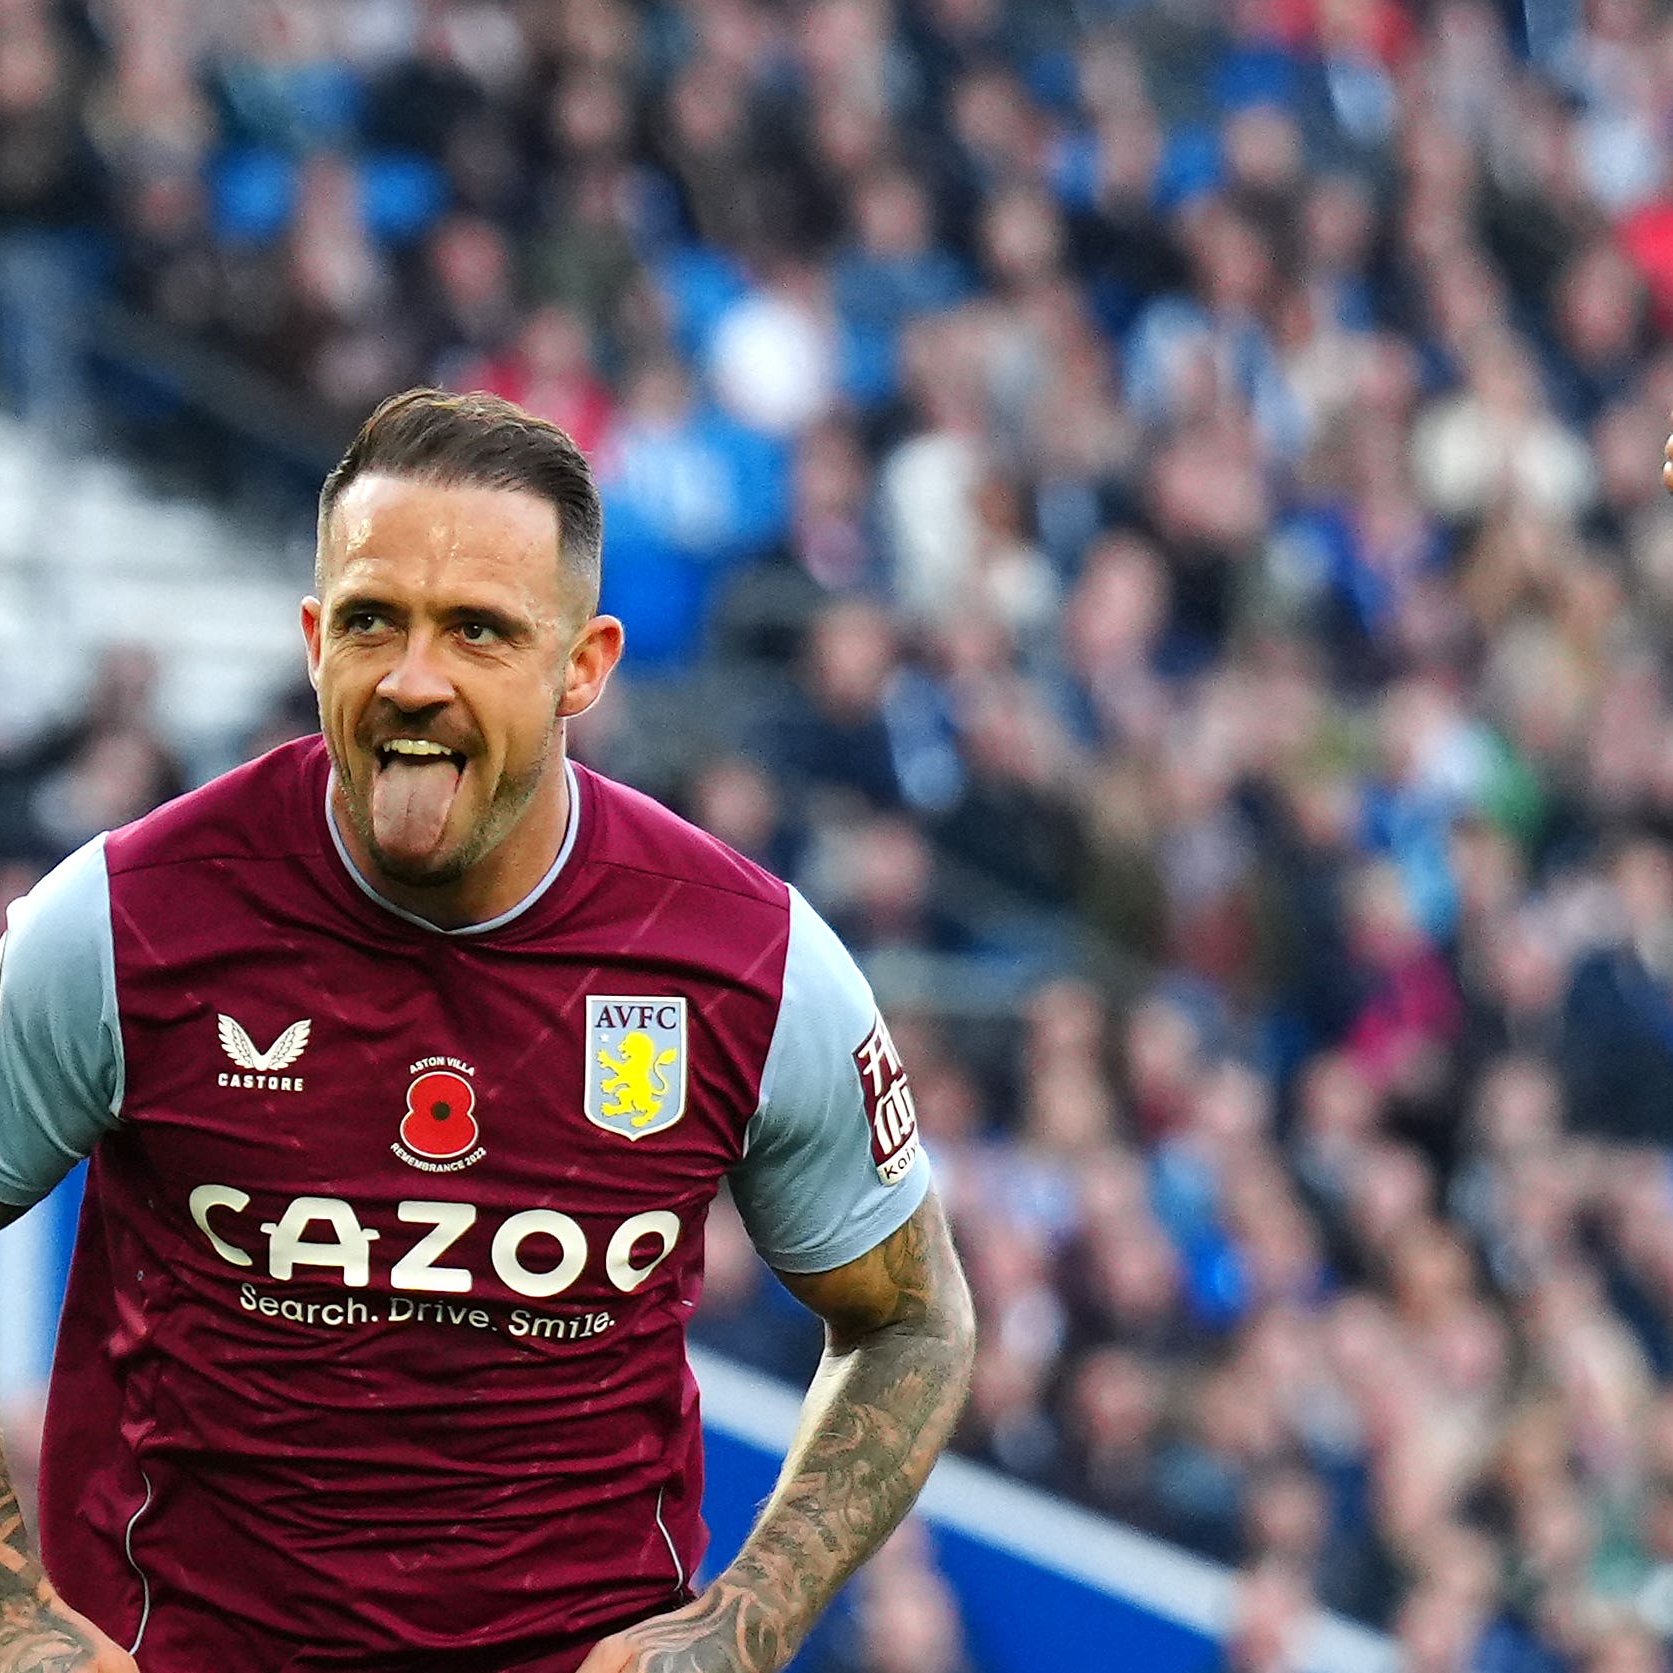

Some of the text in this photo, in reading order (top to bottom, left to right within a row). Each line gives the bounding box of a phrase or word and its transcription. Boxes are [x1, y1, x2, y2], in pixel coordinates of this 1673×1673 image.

[595, 1005, 677, 1030] AVFC
[410, 1056, 475, 1077] ASTON VILLA
[217, 1073, 304, 1092] CASTORE
[390, 1142, 487, 1172] REMEMBRANCE 2022
[189, 1184, 681, 1298] CAZOO
[240, 1283, 616, 1340] Search. Drive. Smile.
